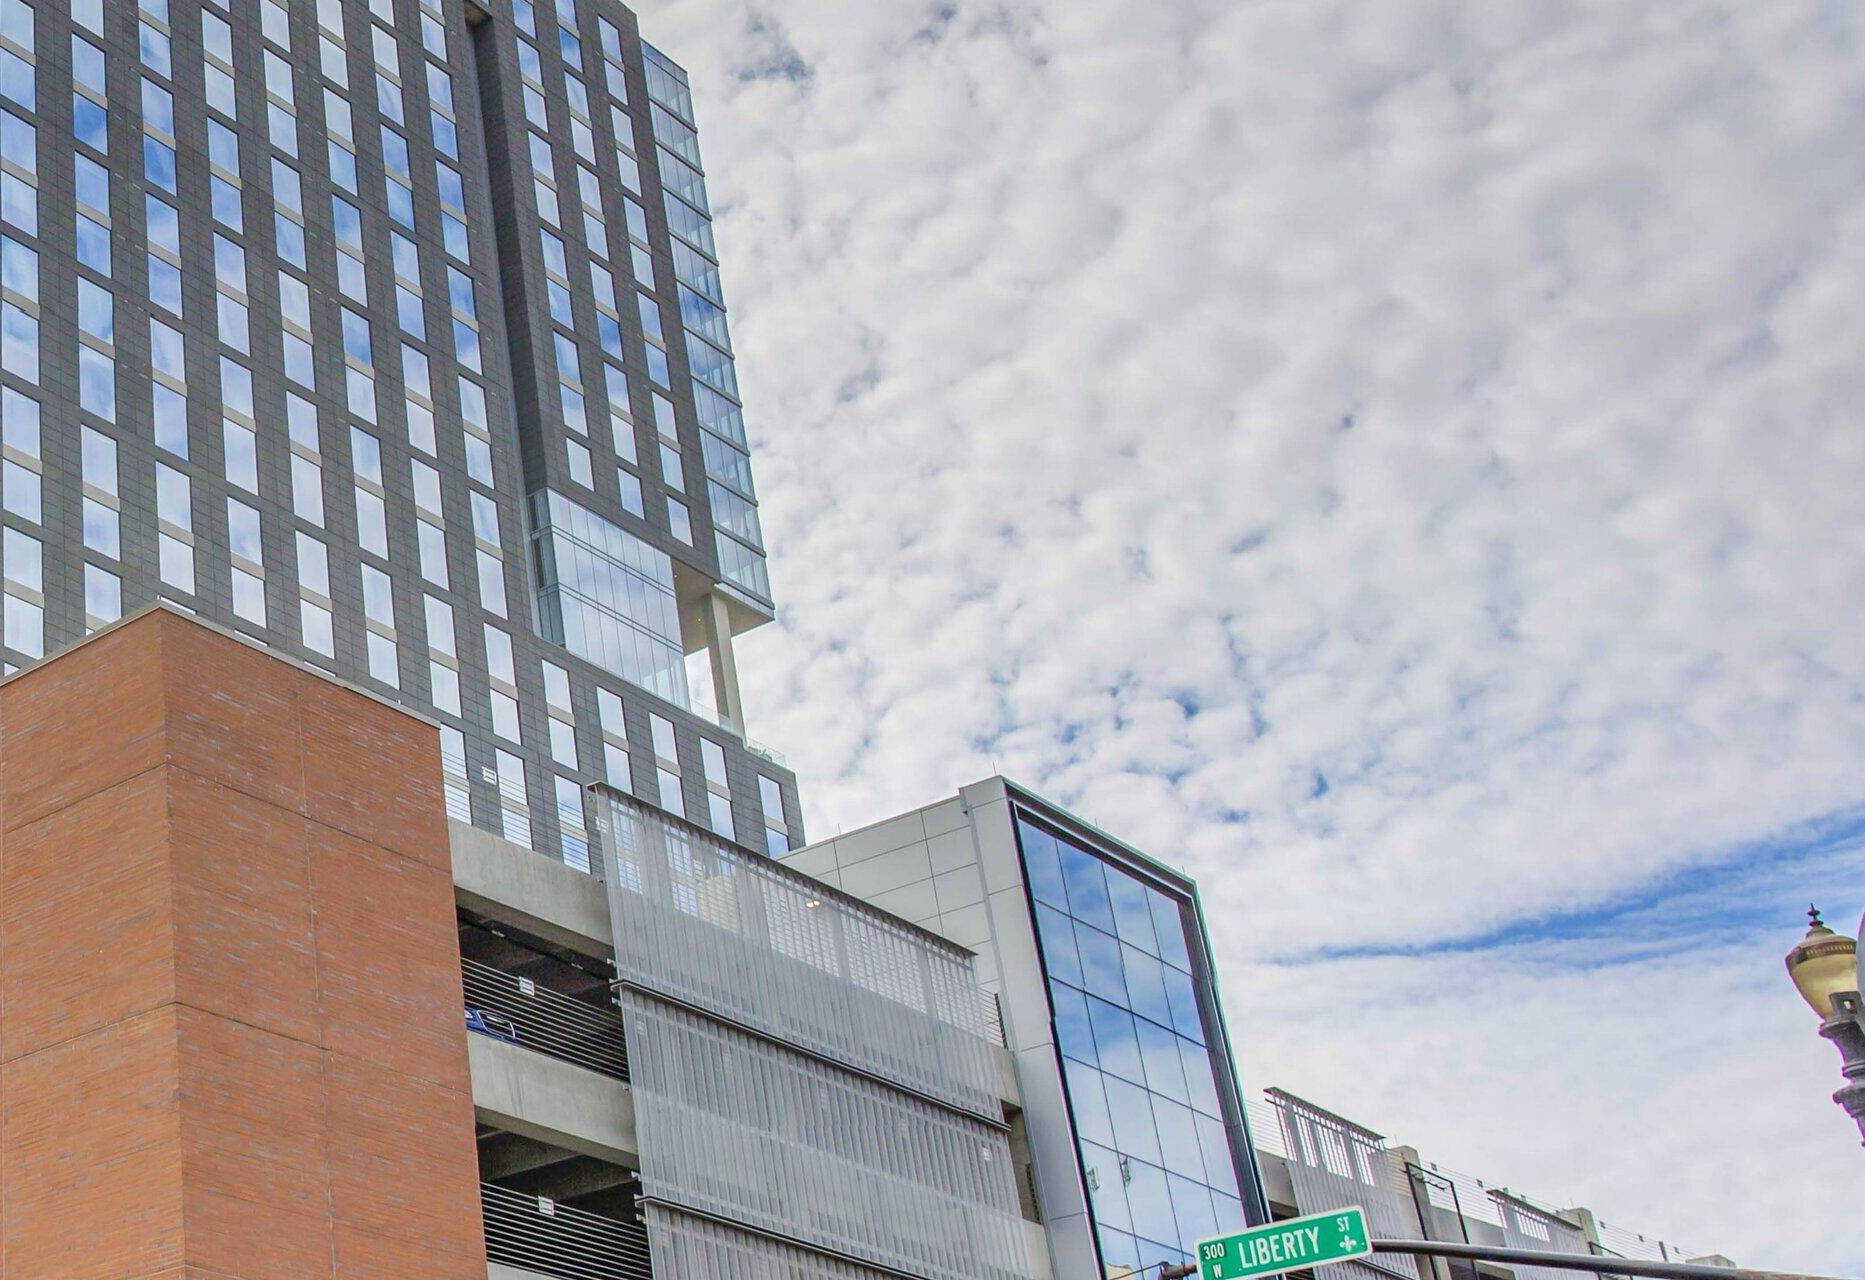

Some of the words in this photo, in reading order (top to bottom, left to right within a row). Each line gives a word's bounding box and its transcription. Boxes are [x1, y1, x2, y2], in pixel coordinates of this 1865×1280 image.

[1203, 1242, 1226, 1261] 300
[1237, 1226, 1320, 1270] LIBERTY
[1336, 1216, 1351, 1233] ST
[1211, 1263, 1223, 1279] W
